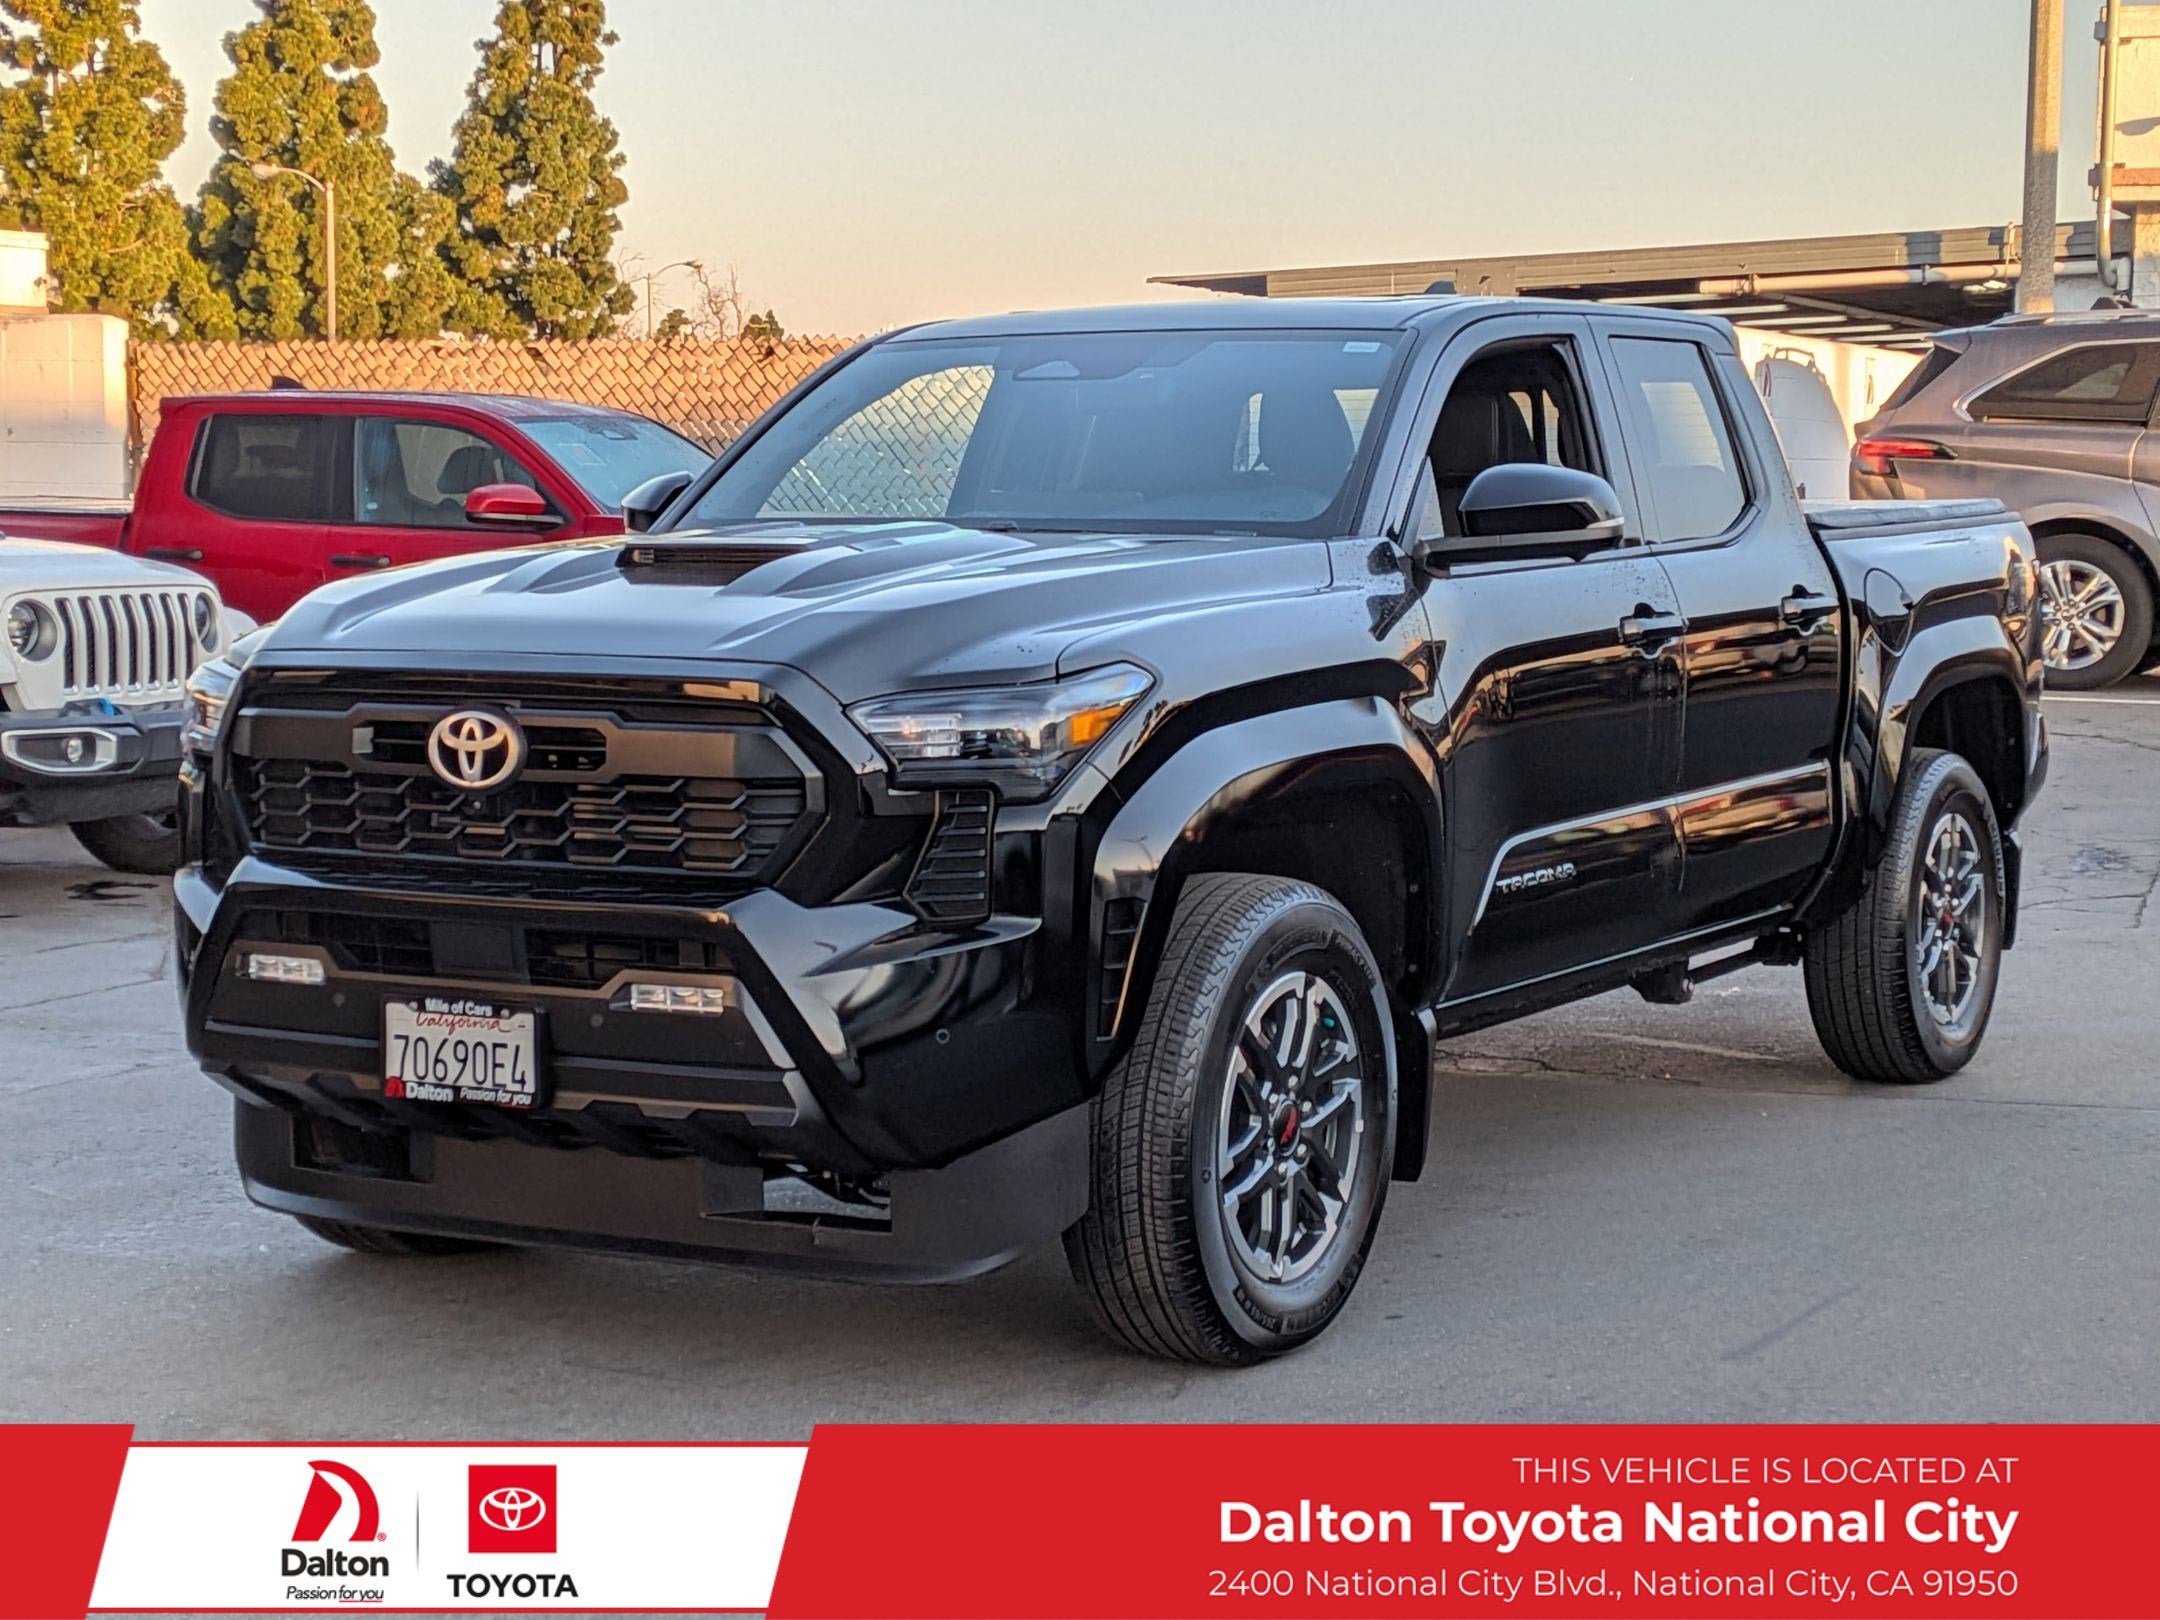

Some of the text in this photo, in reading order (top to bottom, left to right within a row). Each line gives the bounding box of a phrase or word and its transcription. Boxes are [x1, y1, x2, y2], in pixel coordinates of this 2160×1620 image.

[450, 1001, 464, 1014] of
[465, 1002, 493, 1016] Cars
[415, 1010, 511, 1036] California
[393, 1034, 528, 1092] 70690E4
[405, 1081, 533, 1106] Dalton Passion for you
